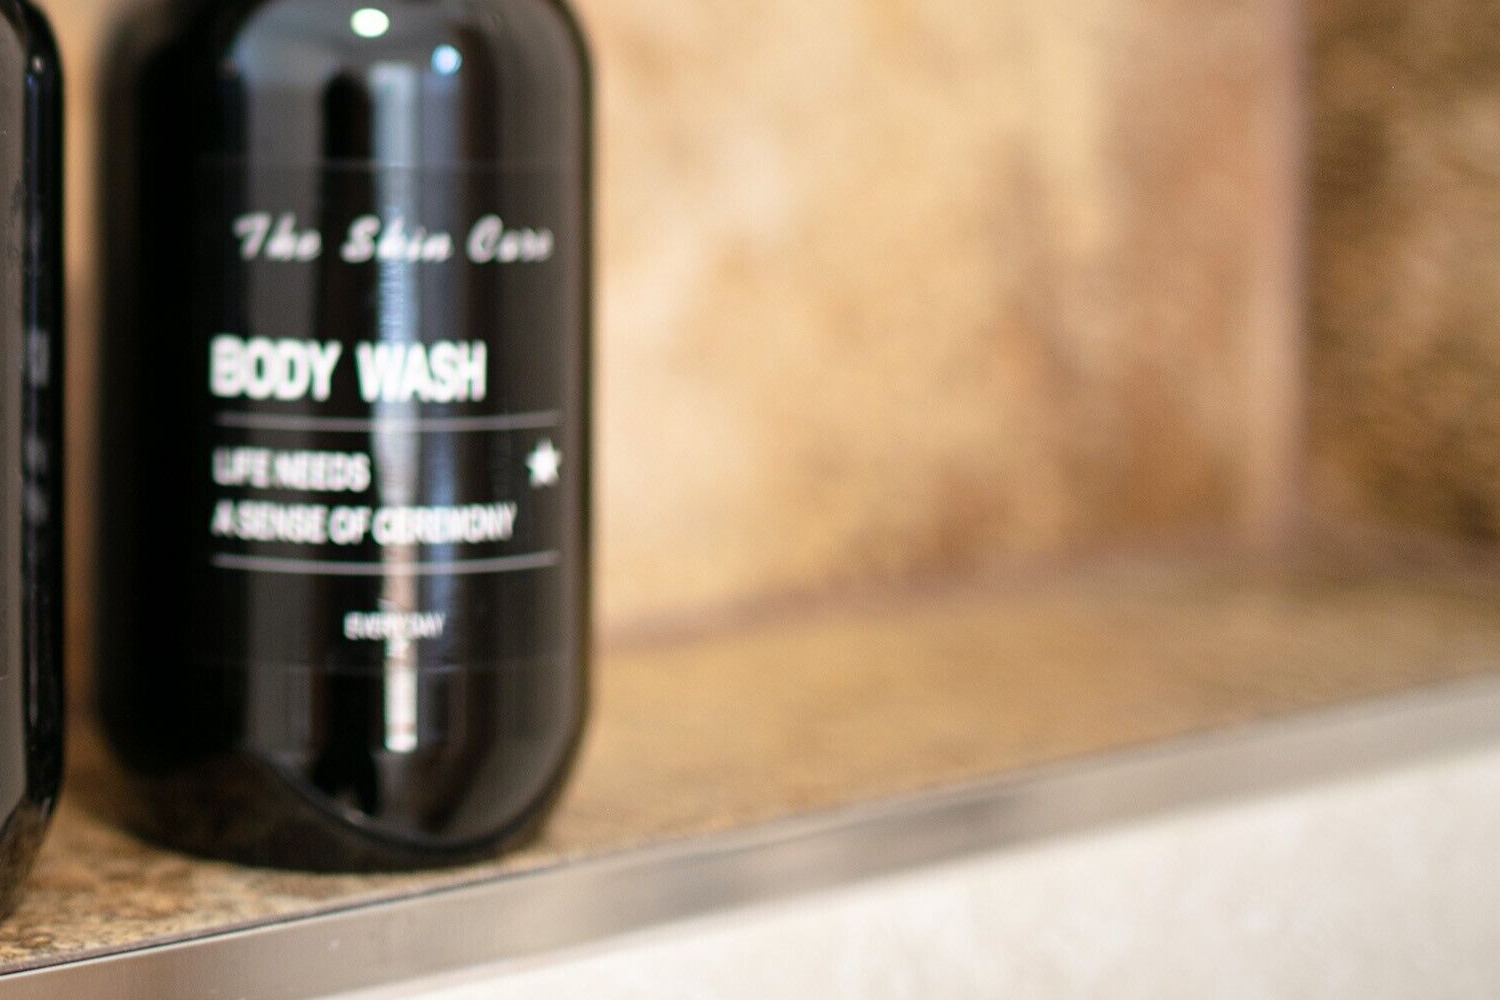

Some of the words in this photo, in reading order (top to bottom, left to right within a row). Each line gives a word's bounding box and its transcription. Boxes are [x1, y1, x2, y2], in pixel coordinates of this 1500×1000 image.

[233, 212, 322, 260] The
[341, 215, 453, 262] Skin
[209, 334, 343, 401] BODY
[355, 340, 489, 402] WASH
[330, 506, 371, 545] OF
